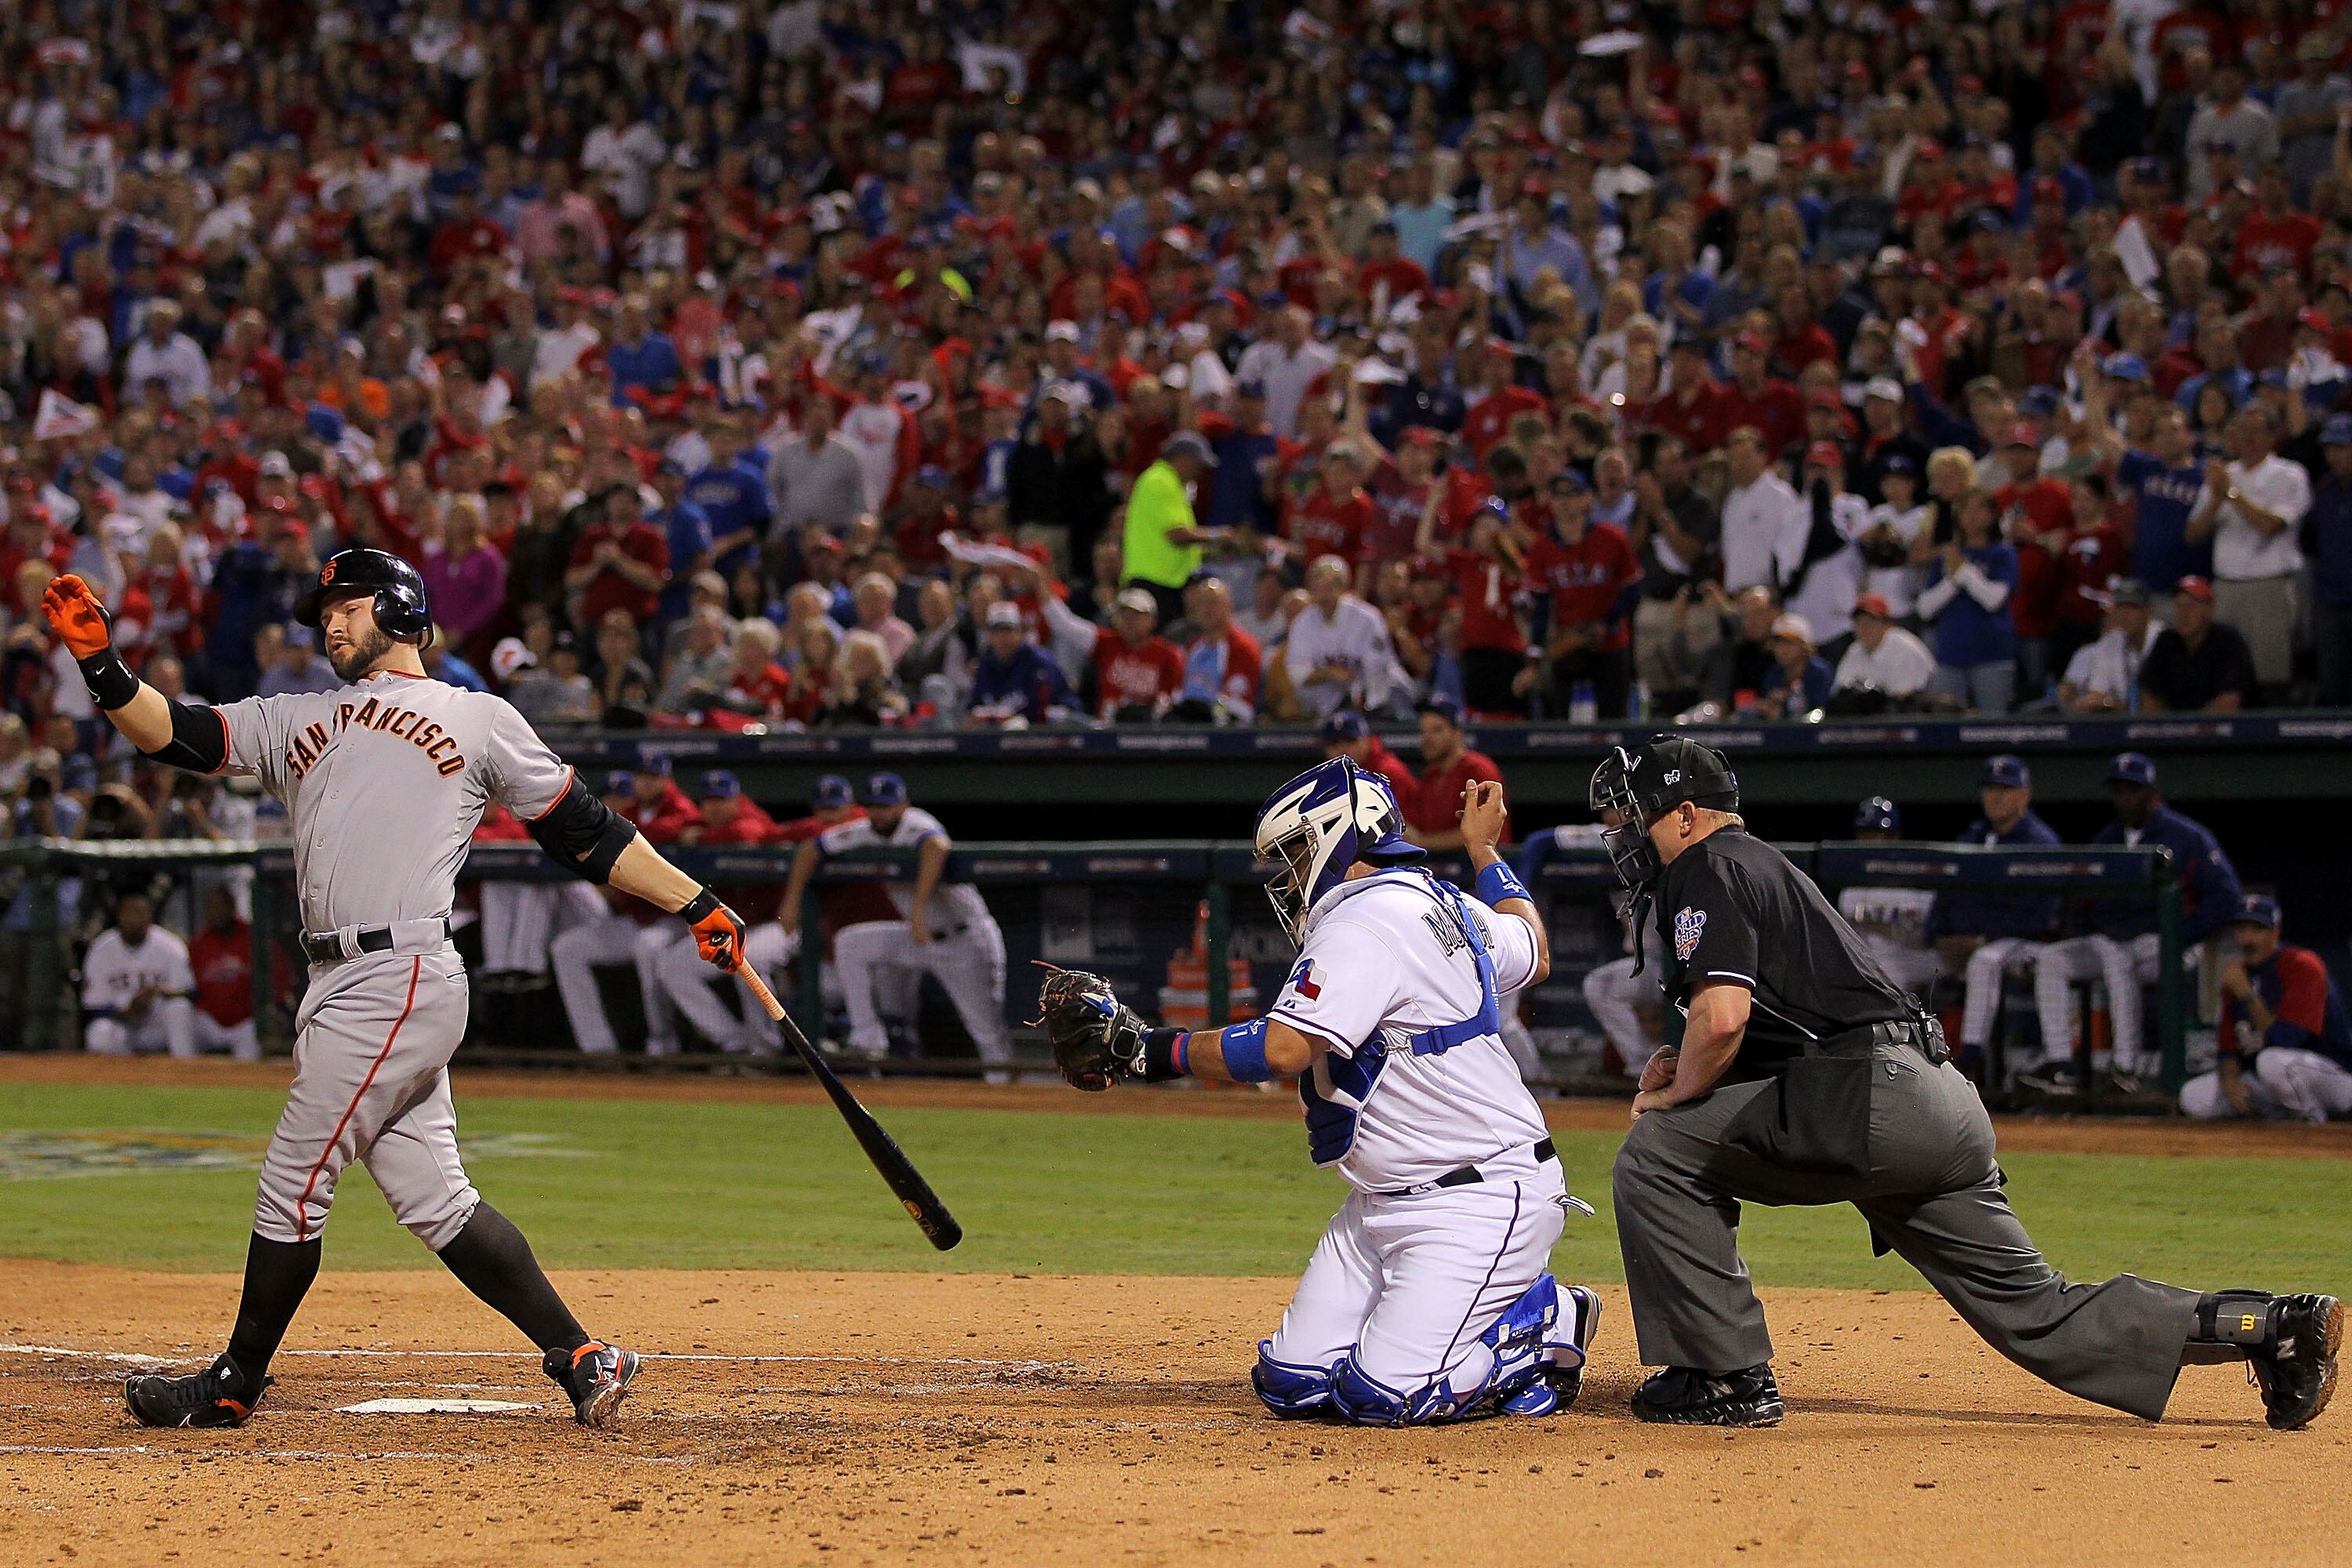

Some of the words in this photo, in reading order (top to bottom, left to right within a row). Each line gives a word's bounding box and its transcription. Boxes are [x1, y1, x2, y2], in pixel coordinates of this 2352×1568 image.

[285, 721, 330, 781] SAN
[1675, 913, 1704, 938] ORLD
[1677, 928, 1700, 946] ERIES
